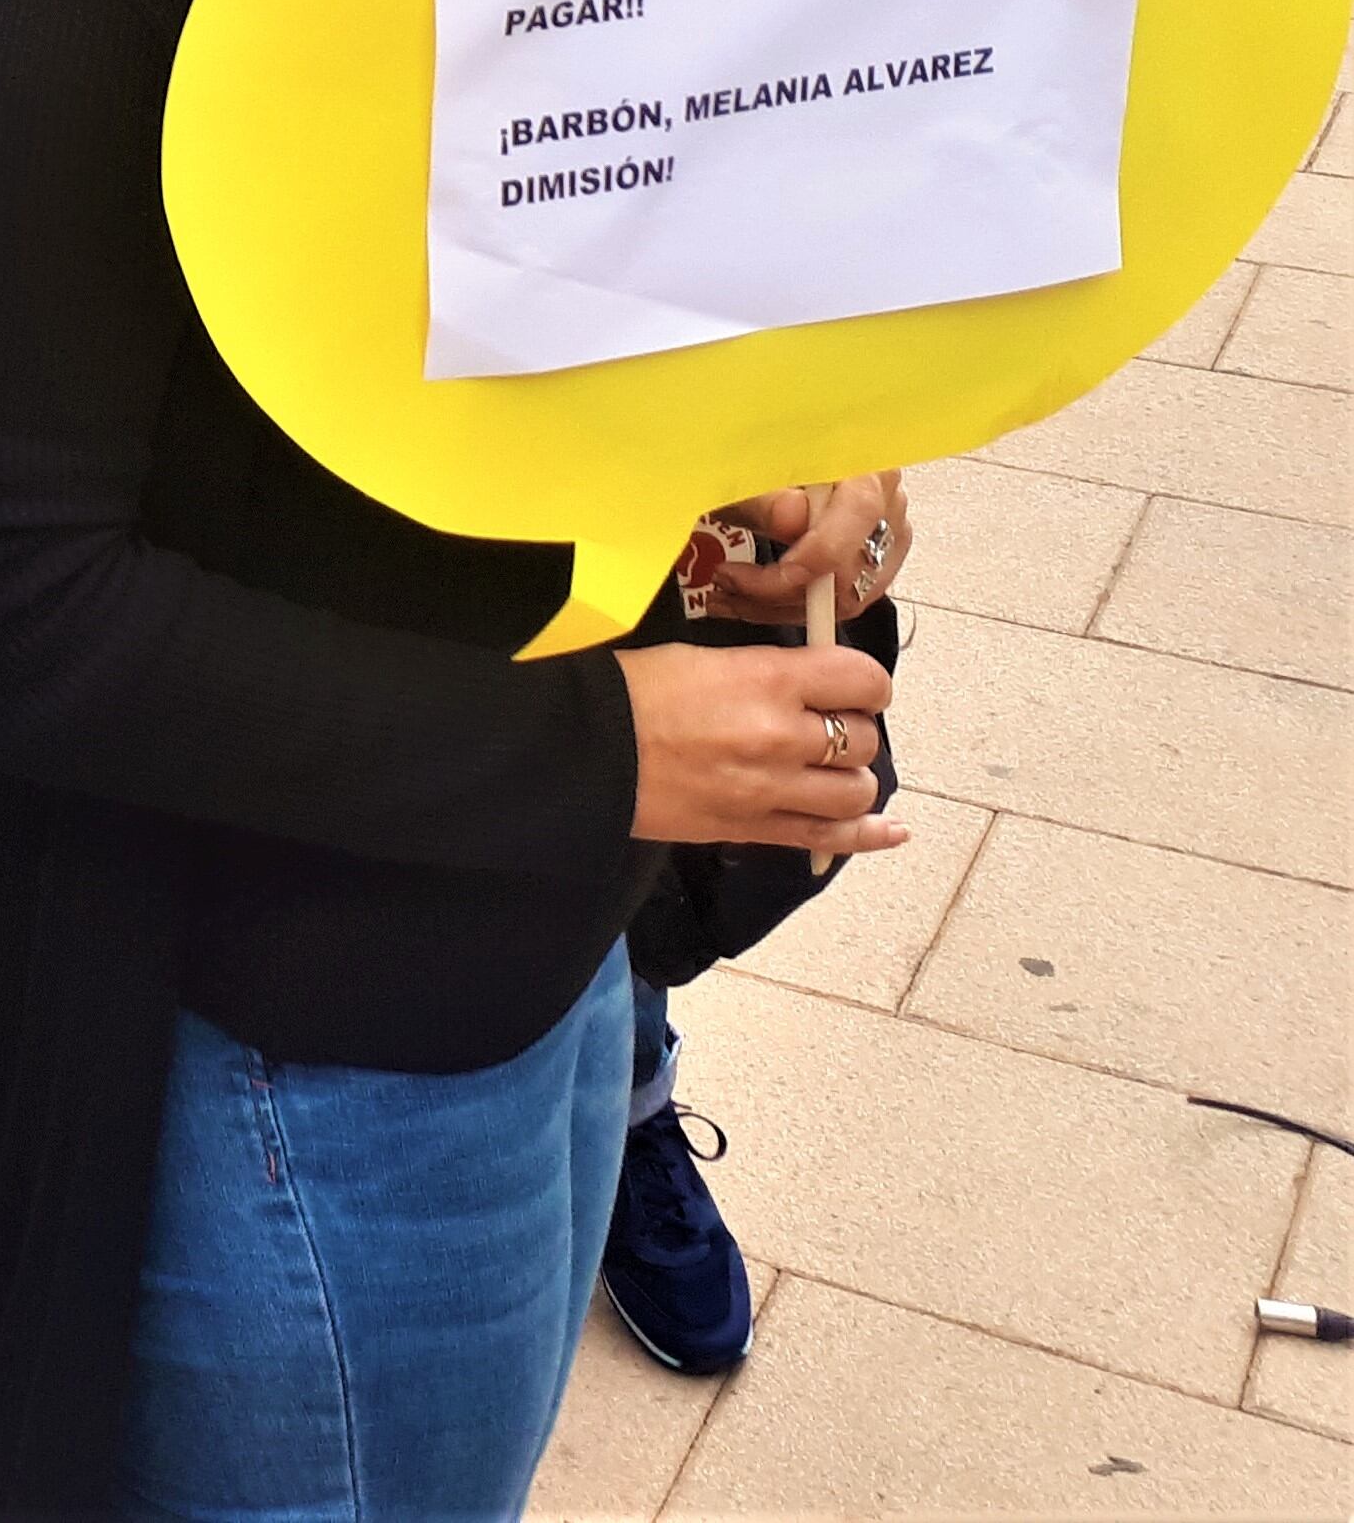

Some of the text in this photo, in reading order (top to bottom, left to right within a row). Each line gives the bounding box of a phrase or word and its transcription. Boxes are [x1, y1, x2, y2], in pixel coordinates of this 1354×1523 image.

[500, 46, 994, 157] ¡BARBÓN, MELANIA ALVAREZ
[501, 155, 675, 208] DIMISIÓN!
